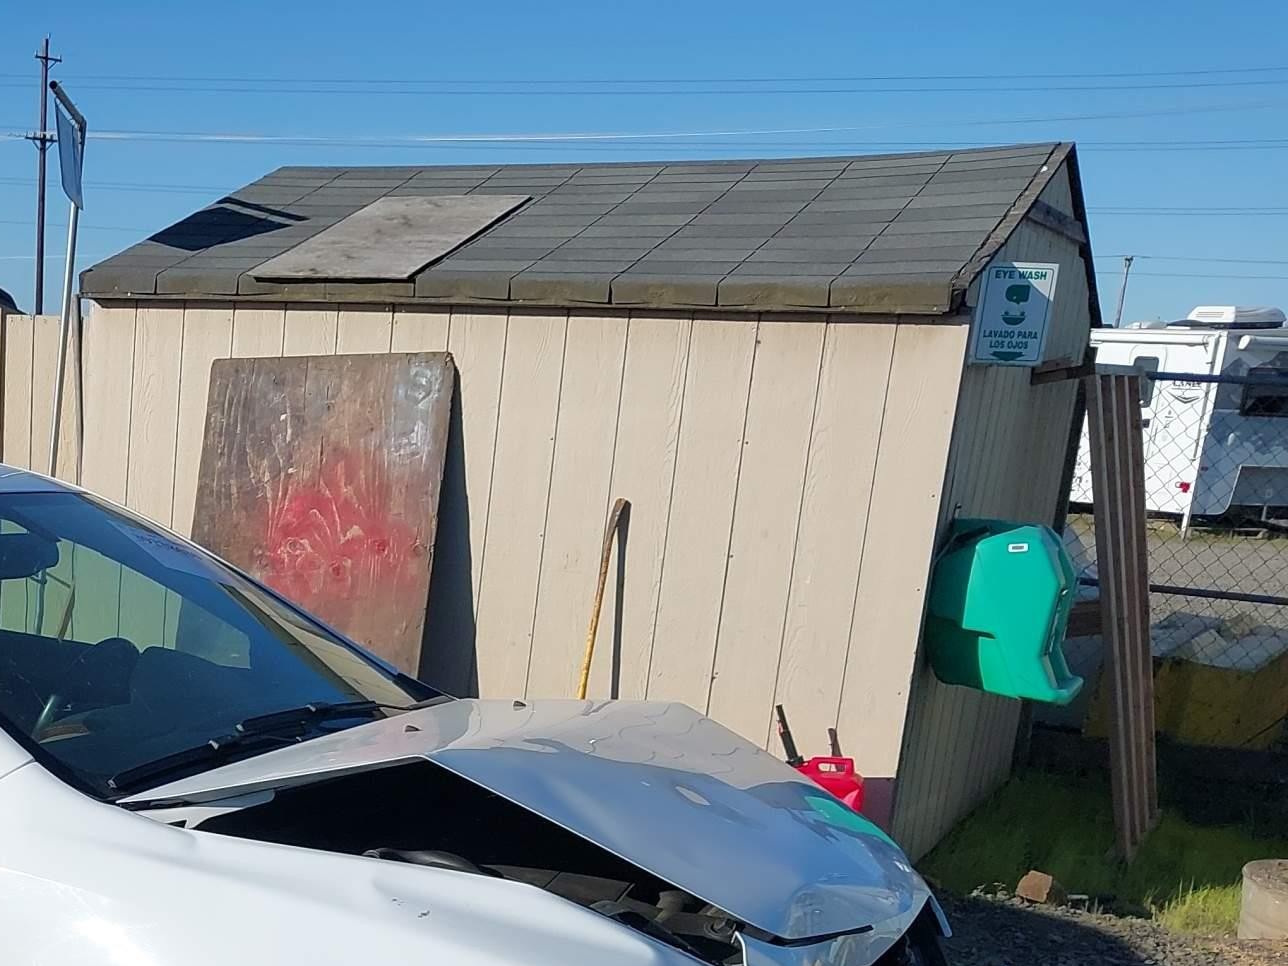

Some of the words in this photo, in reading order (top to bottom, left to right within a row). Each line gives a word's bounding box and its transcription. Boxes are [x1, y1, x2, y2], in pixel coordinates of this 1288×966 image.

[995, 270, 1016, 279] EYE
[1018, 271, 1047, 280] WASH
[983, 329, 1016, 339] LAVADO
[1017, 331, 1039, 340] PARA
[989, 340, 1006, 349] LOS
[1007, 341, 1029, 350] OJOS
